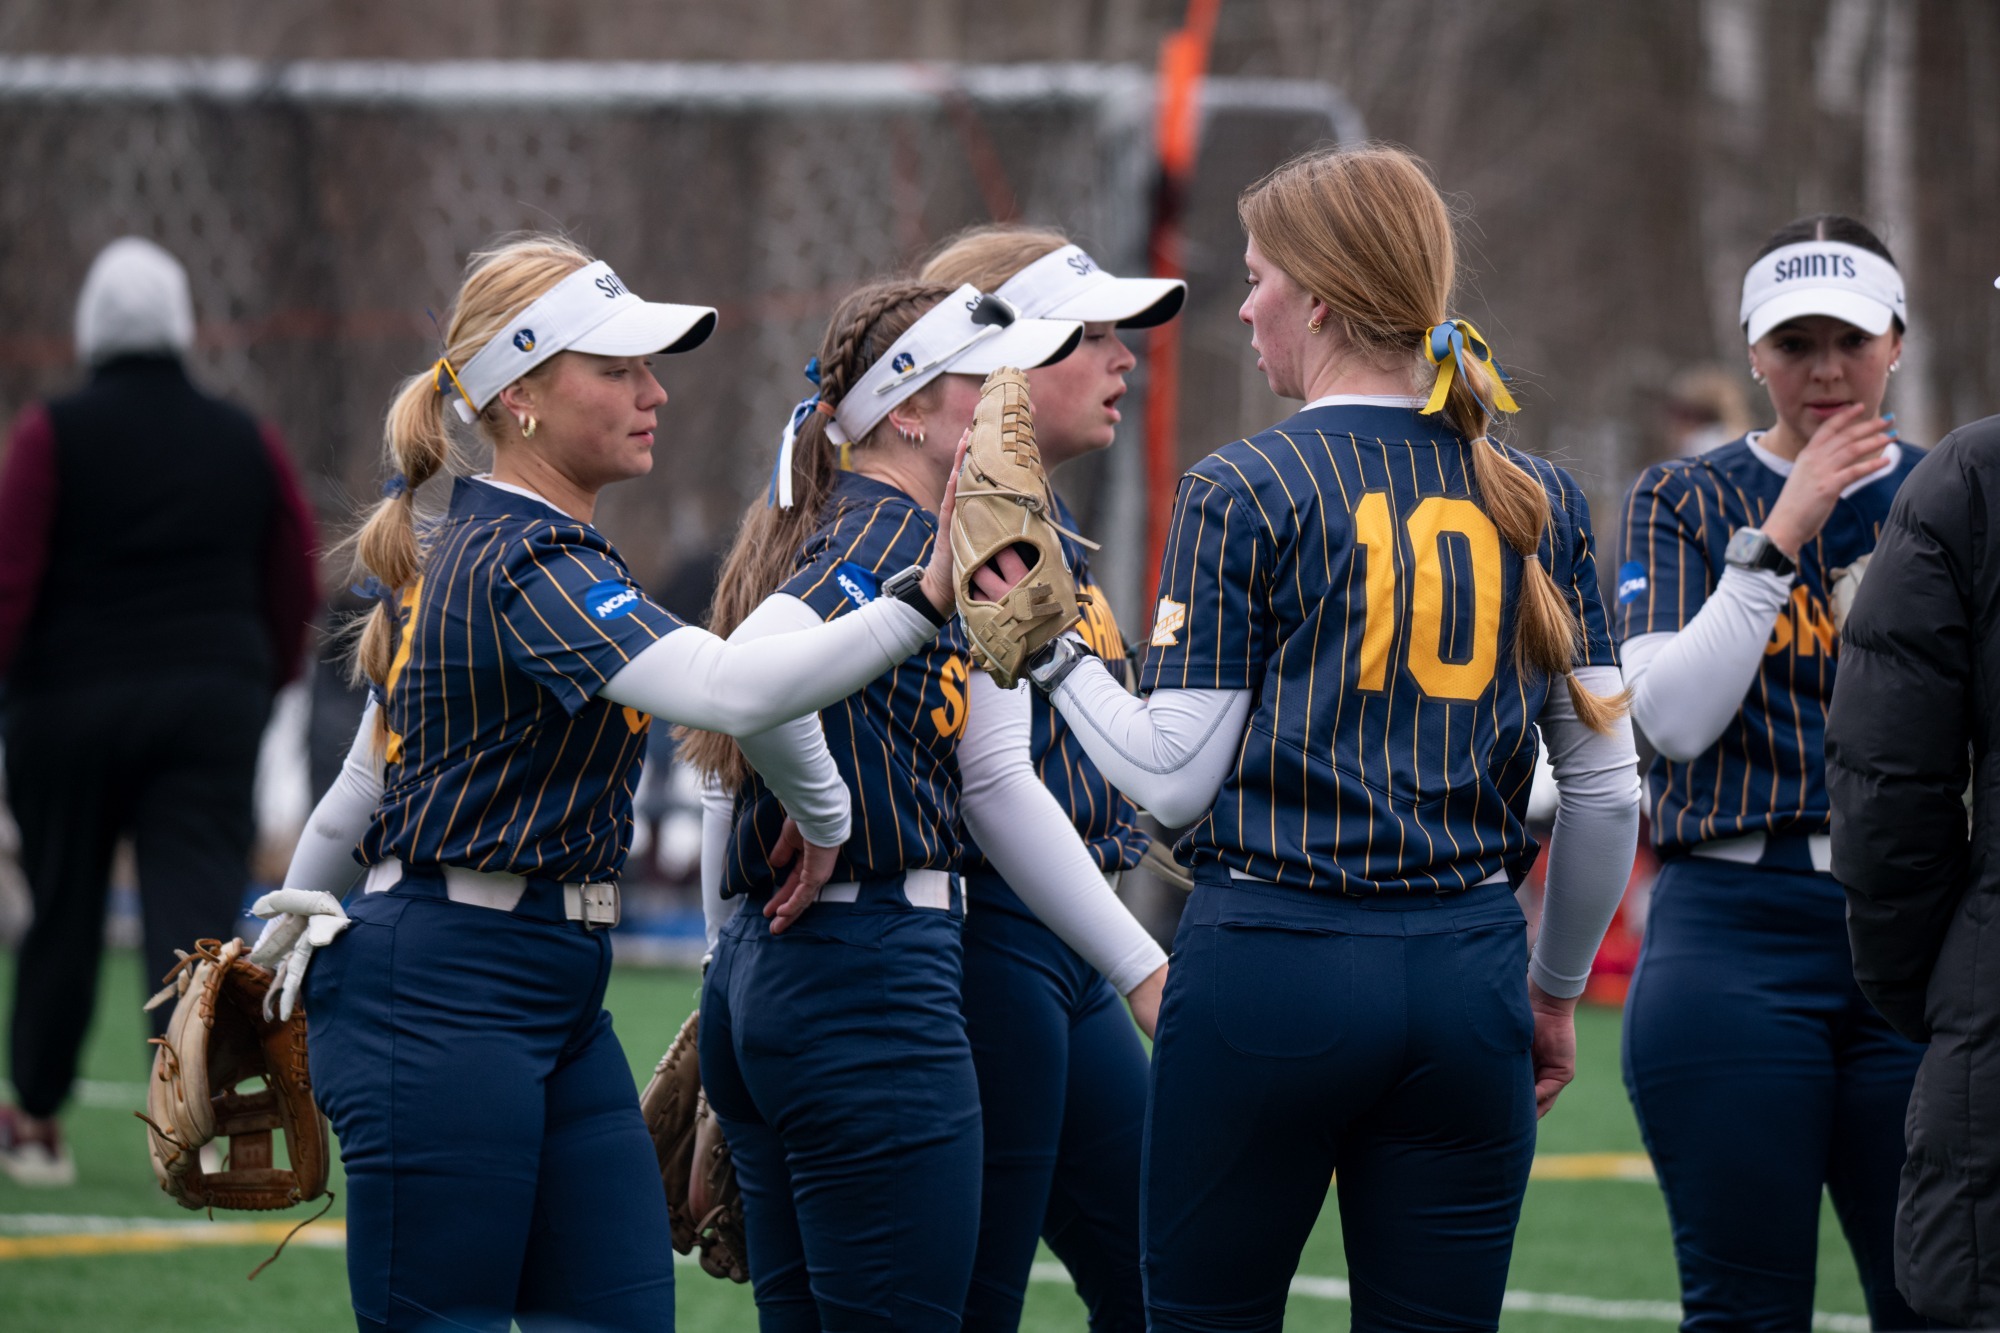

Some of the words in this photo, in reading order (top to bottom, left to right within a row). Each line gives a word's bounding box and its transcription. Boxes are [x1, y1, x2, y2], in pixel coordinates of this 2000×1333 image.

[1774, 254, 1855, 283] SAINTS
[596, 589, 639, 618] NCAA
[1353, 489, 1504, 704] 10
